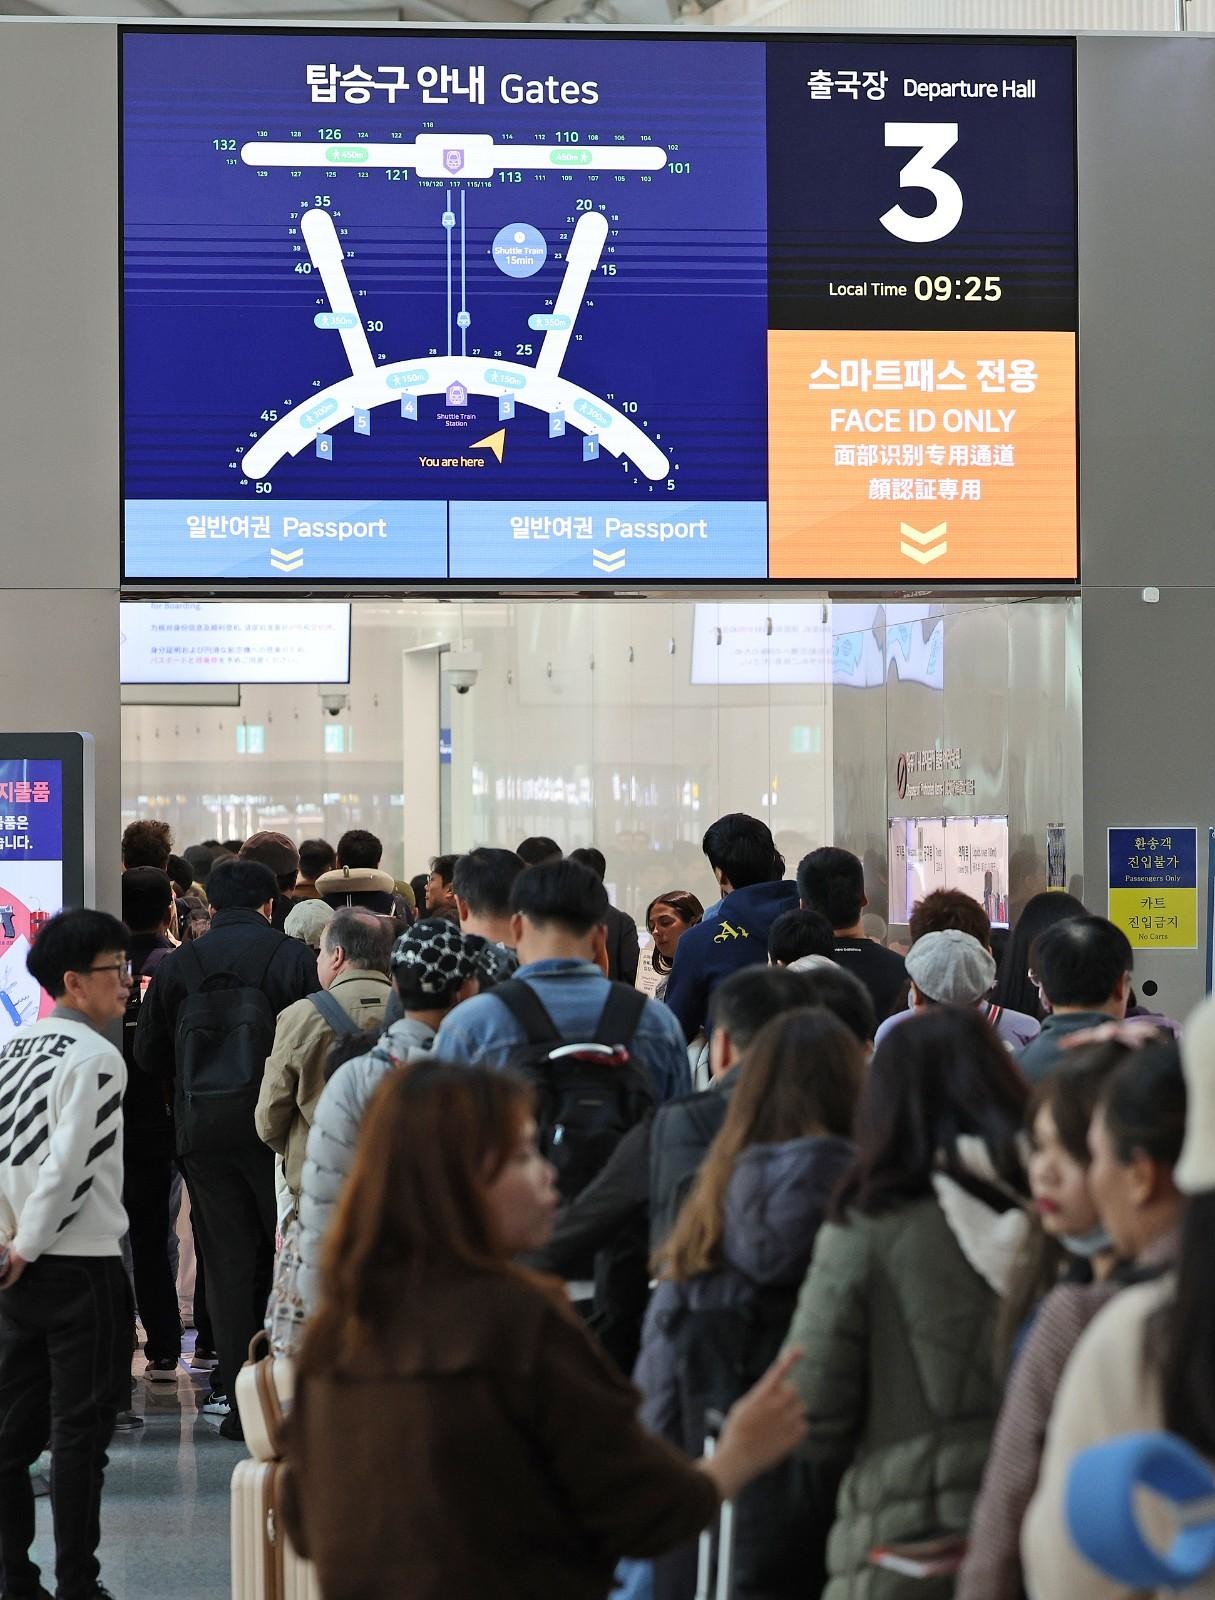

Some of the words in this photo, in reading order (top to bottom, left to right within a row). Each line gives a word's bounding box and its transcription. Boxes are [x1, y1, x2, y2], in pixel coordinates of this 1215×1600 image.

[307, 64, 409, 104] 탑승구
[417, 65, 484, 104] 안내
[501, 74, 598, 104] Gates
[808, 69, 888, 100] 출국장
[904, 79, 998, 101] Departure
[1003, 80, 1035, 98] Hall
[319, 129, 341, 139] 126
[556, 132, 578, 142] 110
[213, 140, 236, 150] 132
[669, 163, 689, 173] 101
[386, 170, 407, 180] 121
[499, 172, 521, 182] 113
[879, 122, 963, 242] 3
[315, 196, 330, 206] 35
[576, 199, 592, 210] 20
[495, 247, 522, 255] Shuttle
[524, 247, 543, 255] Train
[505, 256, 533, 265] 15min
[295, 263, 311, 273] 40
[602, 265, 616, 275] 15
[830, 282, 867, 295] Local
[871, 283, 907, 296] Time
[915, 276, 1001, 301] 09:25
[367, 321, 383, 331] 30
[516, 344, 532, 355] 25
[809, 359, 967, 392] 스마트패스
[976, 359, 1038, 392] 전용
[405, 402, 413, 412] 4
[503, 402, 510, 413] 3
[623, 402, 637, 412] 10
[261, 410, 277, 421] 45
[830, 408, 902, 433] FACE
[908, 408, 936, 433] ID
[942, 408, 1017, 433] ONLY
[358, 417, 366, 428] 5
[553, 419, 561, 430] 2
[320, 441, 328, 451] 6
[588, 442, 594, 452] 1
[833, 444, 1016, 467] 面部识别专用通道
[419, 457, 439, 467] You
[441, 459, 459, 467] are
[460, 456, 484, 467] here
[623, 462, 627, 472] 1
[256, 482, 272, 493] 50
[667, 480, 675, 490] 5
[868, 478, 982, 501] 顔認証専用
[186, 515, 272, 540] 일반여권
[282, 516, 388, 541] Passport
[510, 515, 594, 540] 일반여권
[605, 516, 708, 541] Passport
[1134, 837, 1172, 850] 환송객
[1127, 855, 1180, 869] 진입불가
[1125, 875, 1163, 883] Passengers
[1165, 875, 1181, 883] Only
[1140, 897, 1167, 911] 카트
[1128, 916, 1178, 929] 진입금지
